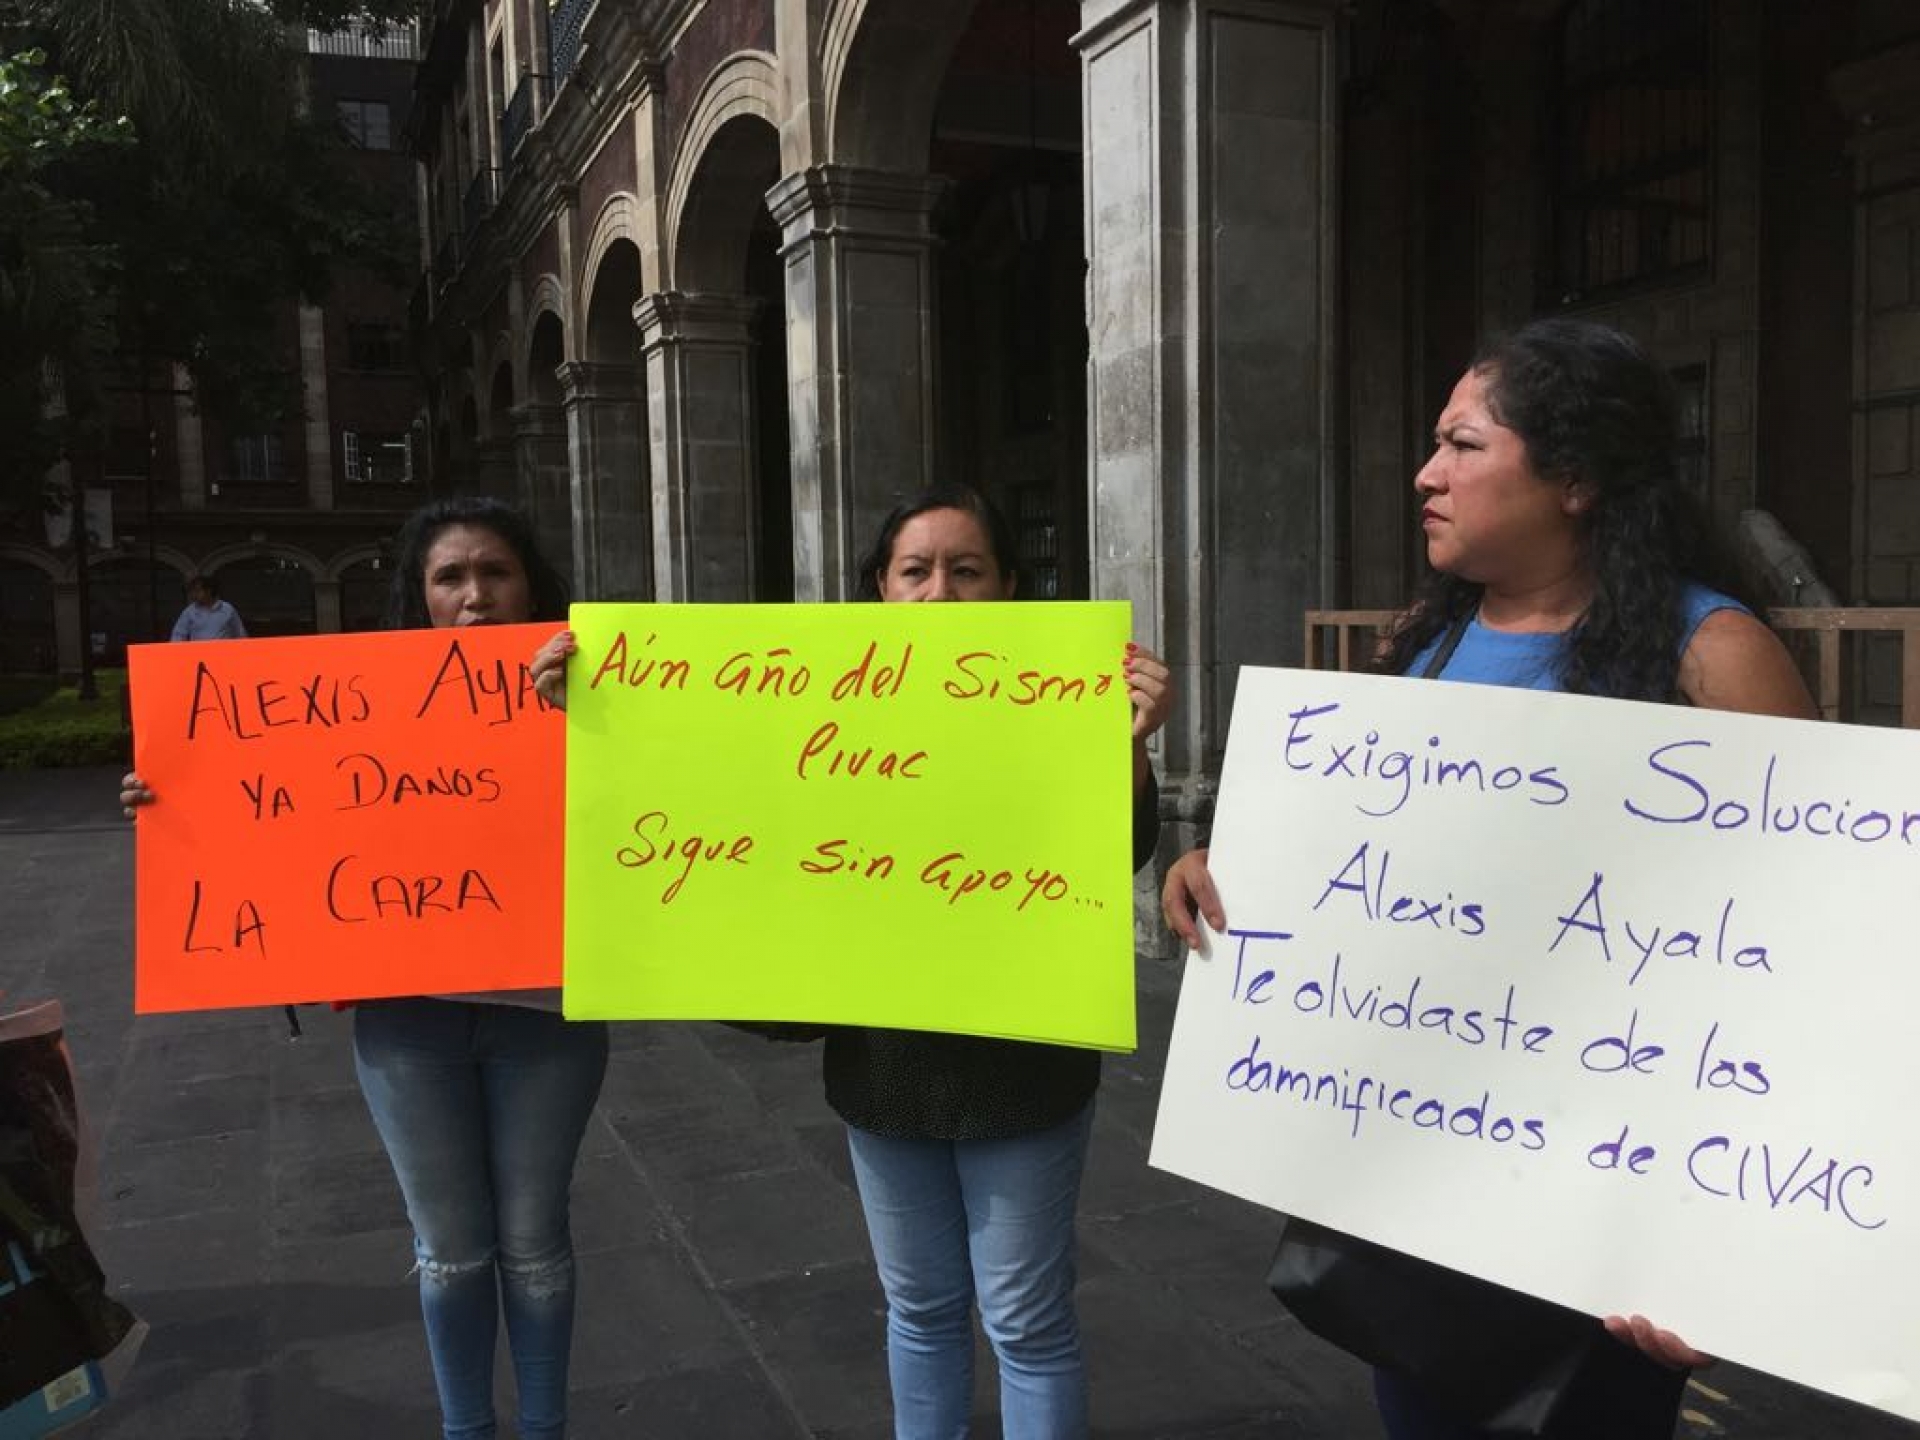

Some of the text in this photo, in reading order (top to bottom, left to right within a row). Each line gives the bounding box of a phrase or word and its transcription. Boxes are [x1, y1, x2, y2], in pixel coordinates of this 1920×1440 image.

[186, 638, 562, 742] ALEXIS AYA
[713, 646, 812, 697] año
[828, 640, 915, 702] del
[239, 752, 502, 821] YA DANOS
[1283, 702, 1571, 818] Exigimos
[182, 853, 503, 960] LA CARA
[614, 809, 756, 906] Sigue
[1312, 840, 1774, 987] Alexis Ayala
[1227, 929, 1772, 1096] Te olvidaste de los
[1224, 1035, 1888, 1231] damnificados de CIVAC
